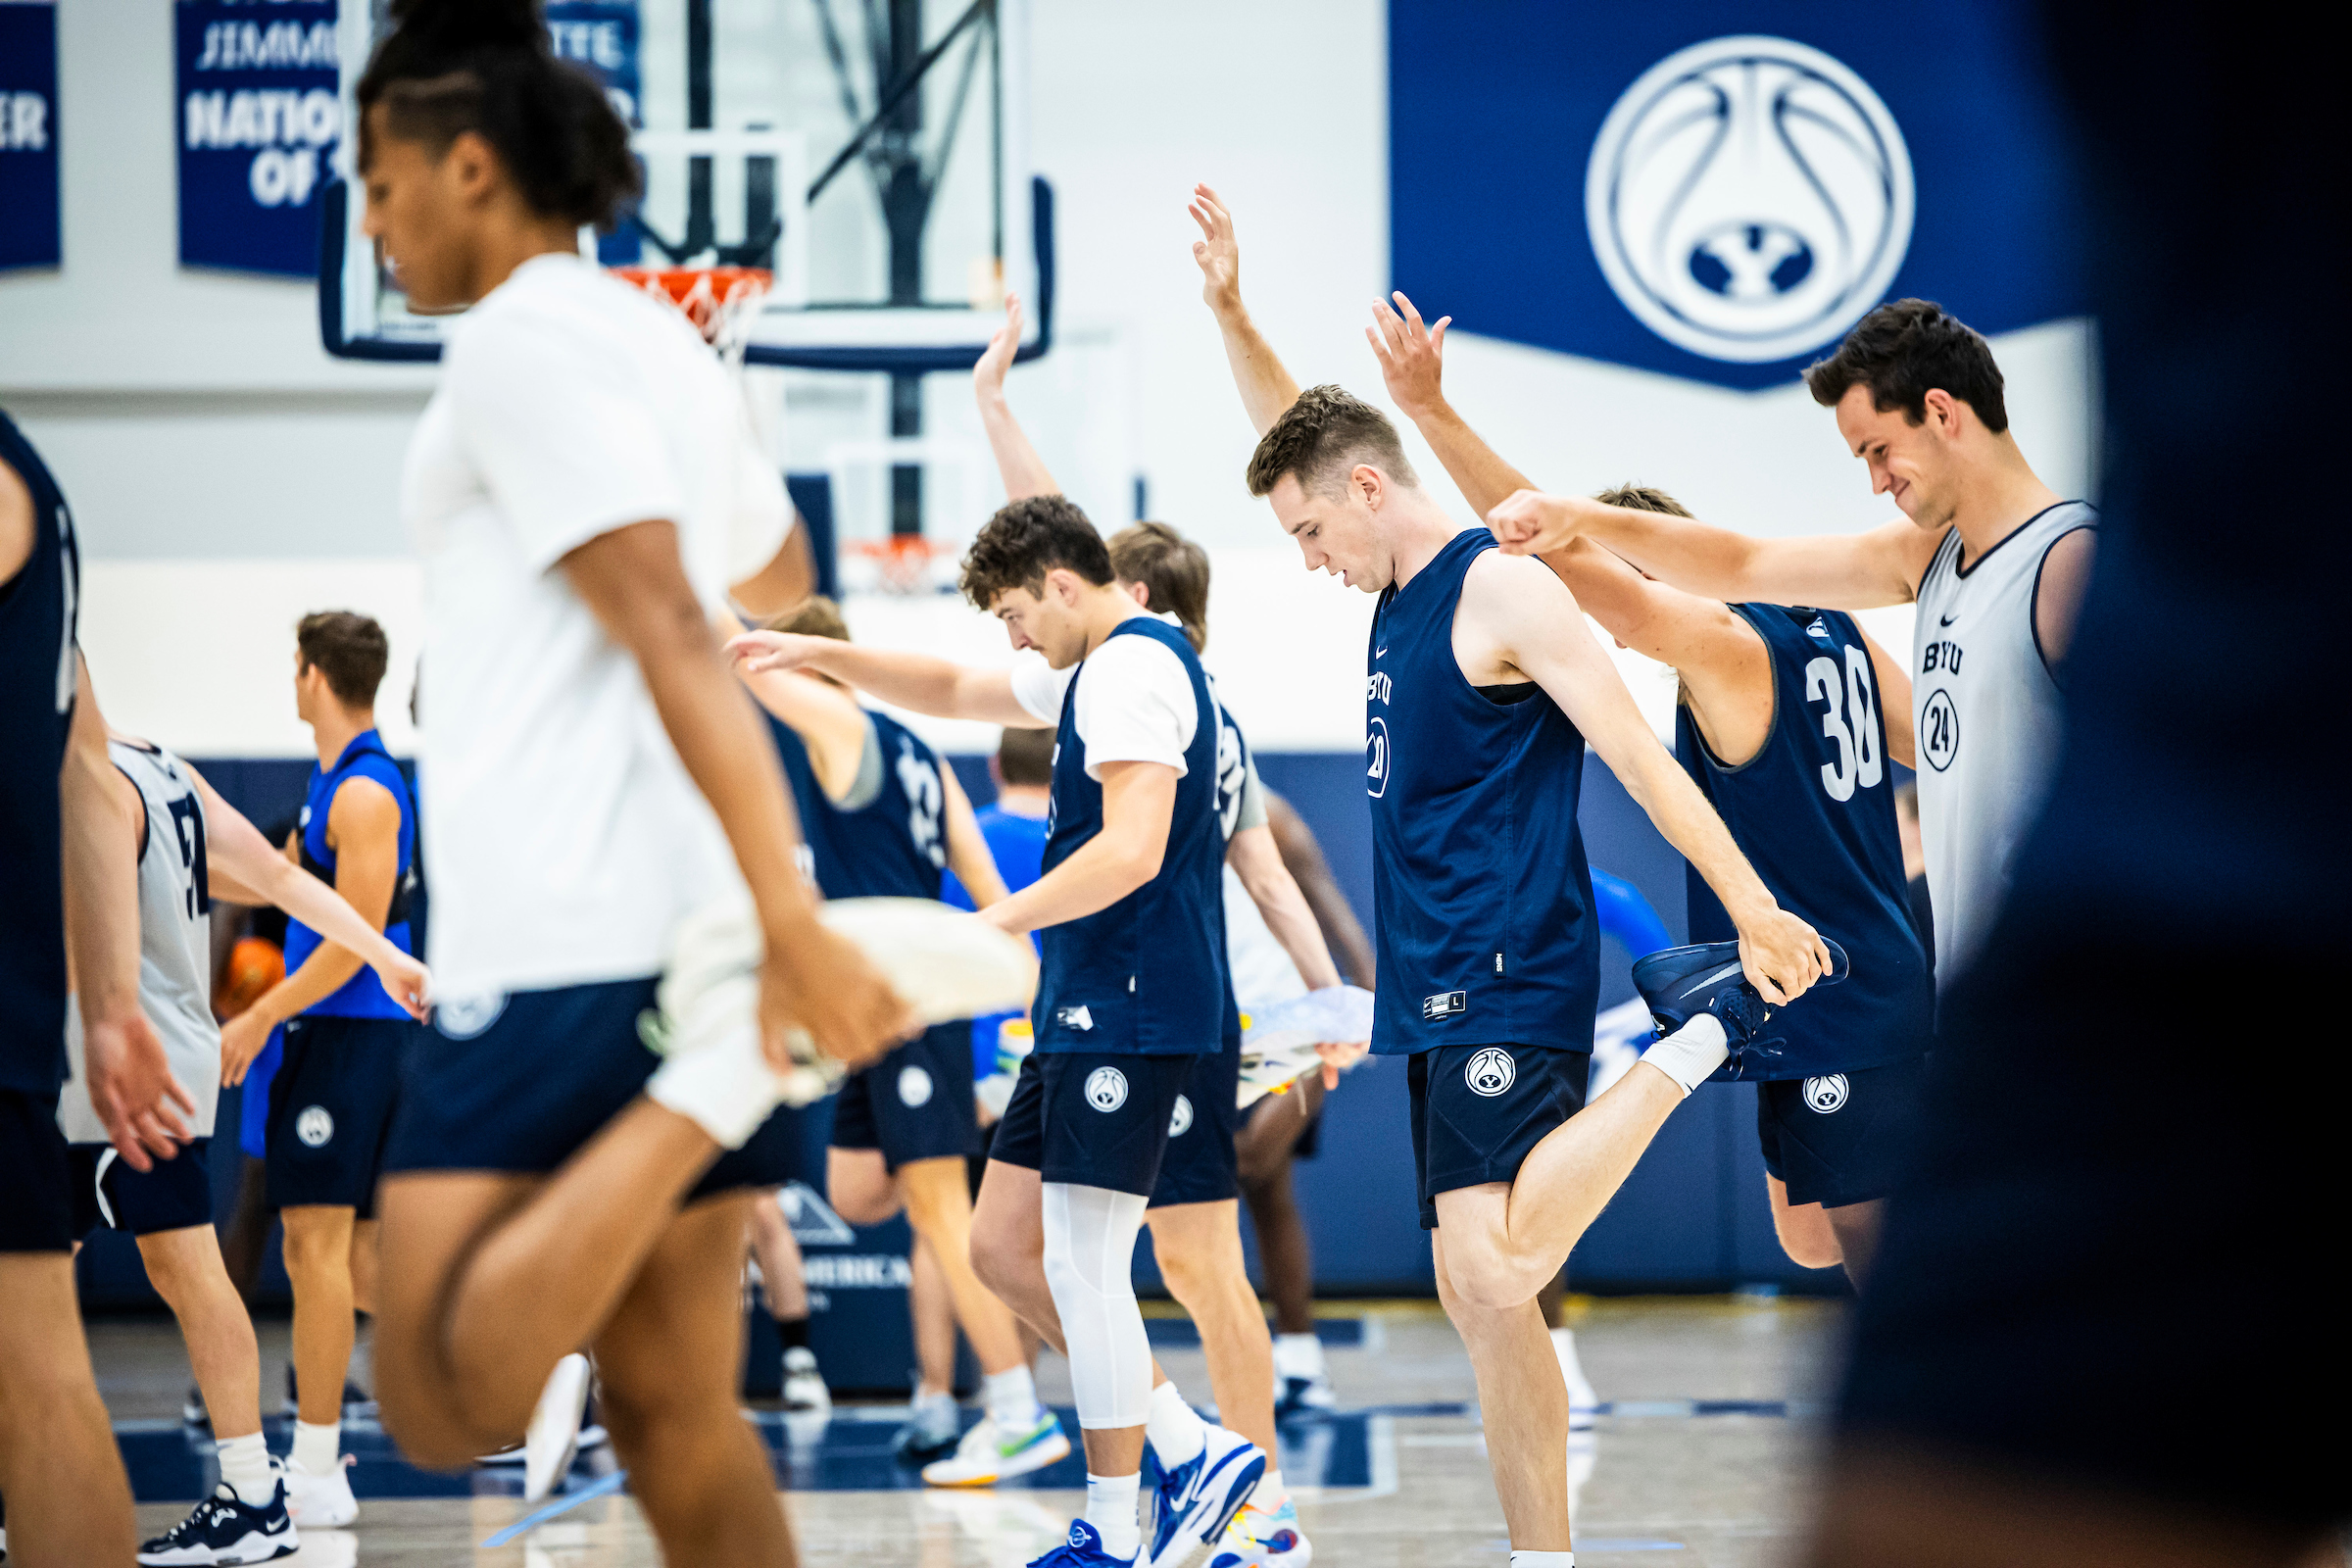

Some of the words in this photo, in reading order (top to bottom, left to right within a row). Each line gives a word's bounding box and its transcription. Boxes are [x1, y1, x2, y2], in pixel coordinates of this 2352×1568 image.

[185, 88, 339, 149] NATIO
[250, 149, 319, 208] OF
[1922, 641, 1963, 676] BYU
[1367, 670, 1393, 707] BYU
[1805, 644, 1883, 803] 30
[1931, 706, 1948, 753] 24
